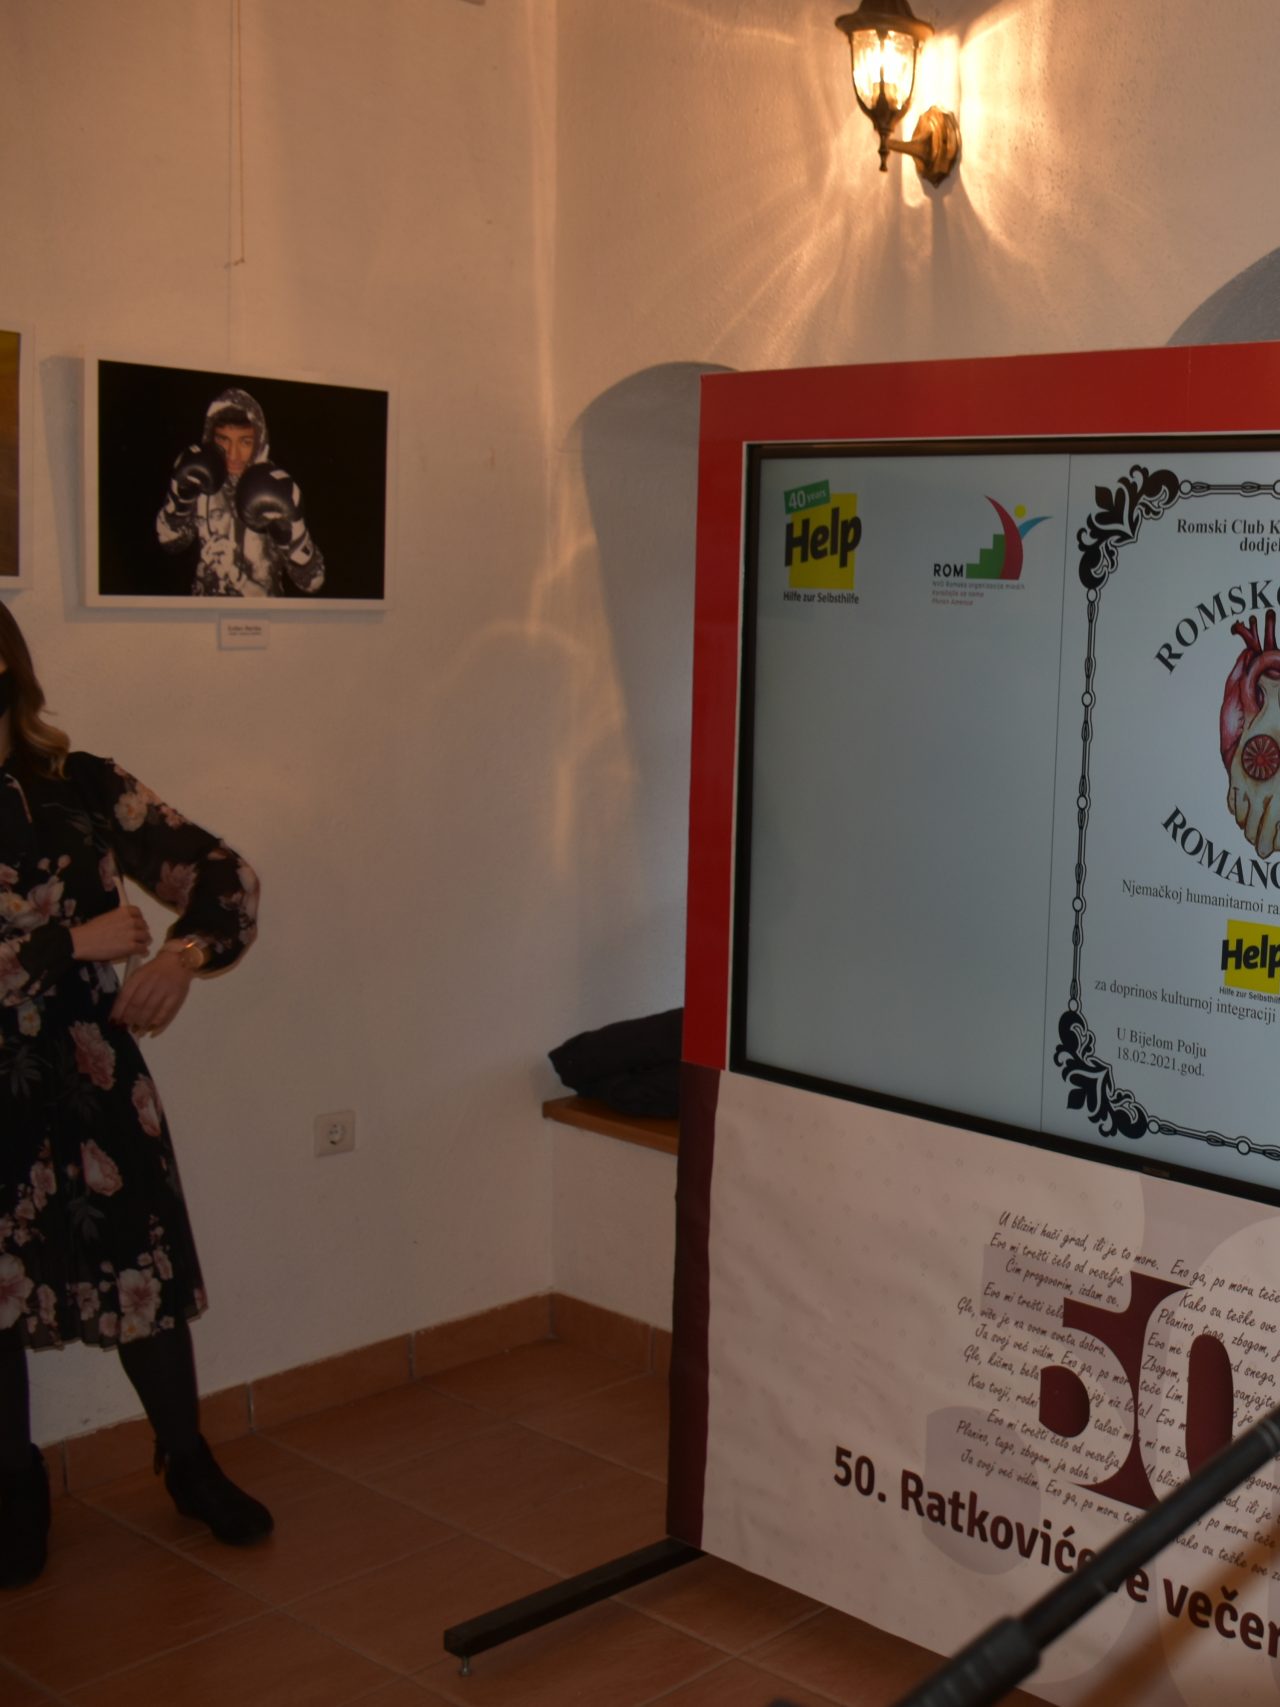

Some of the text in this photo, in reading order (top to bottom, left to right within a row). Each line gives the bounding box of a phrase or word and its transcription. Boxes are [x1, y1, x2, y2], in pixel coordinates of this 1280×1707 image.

[789, 490, 806, 509] 40
[785, 507, 862, 568] Help
[1177, 519, 1227, 534] Romski
[1231, 519, 1264, 535] Club
[934, 563, 964, 577] ROM
[783, 592, 859, 604] Hilfe zur Selbsthilfe
[1122, 879, 1182, 904] Njemačkoj
[1095, 980, 1106, 991] za
[1110, 980, 1158, 1000] doprinos
[1161, 988, 1212, 1014] kulturnoj
[1217, 999, 1276, 1025] integraciji
[1117, 1028, 1207, 1059] U Bijelom Polju
[990, 1232, 1006, 1249] Evo
[1052, 1254, 1070, 1270] čelo
[1074, 1260, 1088, 1273] od
[999, 1211, 1011, 1226] U
[1011, 1216, 1039, 1235] blizini
[1061, 1234, 1089, 1252] grad,
[1093, 1239, 1105, 1252] ili
[1102, 1243, 1117, 1260] je
[1122, 1246, 1130, 1259] to
[1134, 1255, 1159, 1270] more.
[1171, 1259, 1189, 1277] Eno
[1190, 1271, 1206, 1286] ga,
[1210, 1277, 1224, 1292] po
[1229, 1283, 1253, 1296] moru
[1259, 1286, 1280, 1303] teče
[1005, 1255, 1022, 1273] Čim
[984, 1282, 1000, 1298] Evo
[997, 1312, 1010, 1328] je
[1179, 1292, 1206, 1313] Kako
[1227, 1309, 1255, 1326] teške
[1260, 1321, 1277, 1333] ove
[1148, 1332, 1165, 1349] Evo
[1232, 1333, 1270, 1358] zbogom,
[1139, 1378, 1185, 1404] teče Lim.
[1156, 1408, 1175, 1426] Evo
[987, 1408, 1003, 1426] Evo
[1072, 1442, 1085, 1454] od
[834, 1446, 887, 1503] 50.
[901, 1469, 1150, 1604] Ratkovićee
